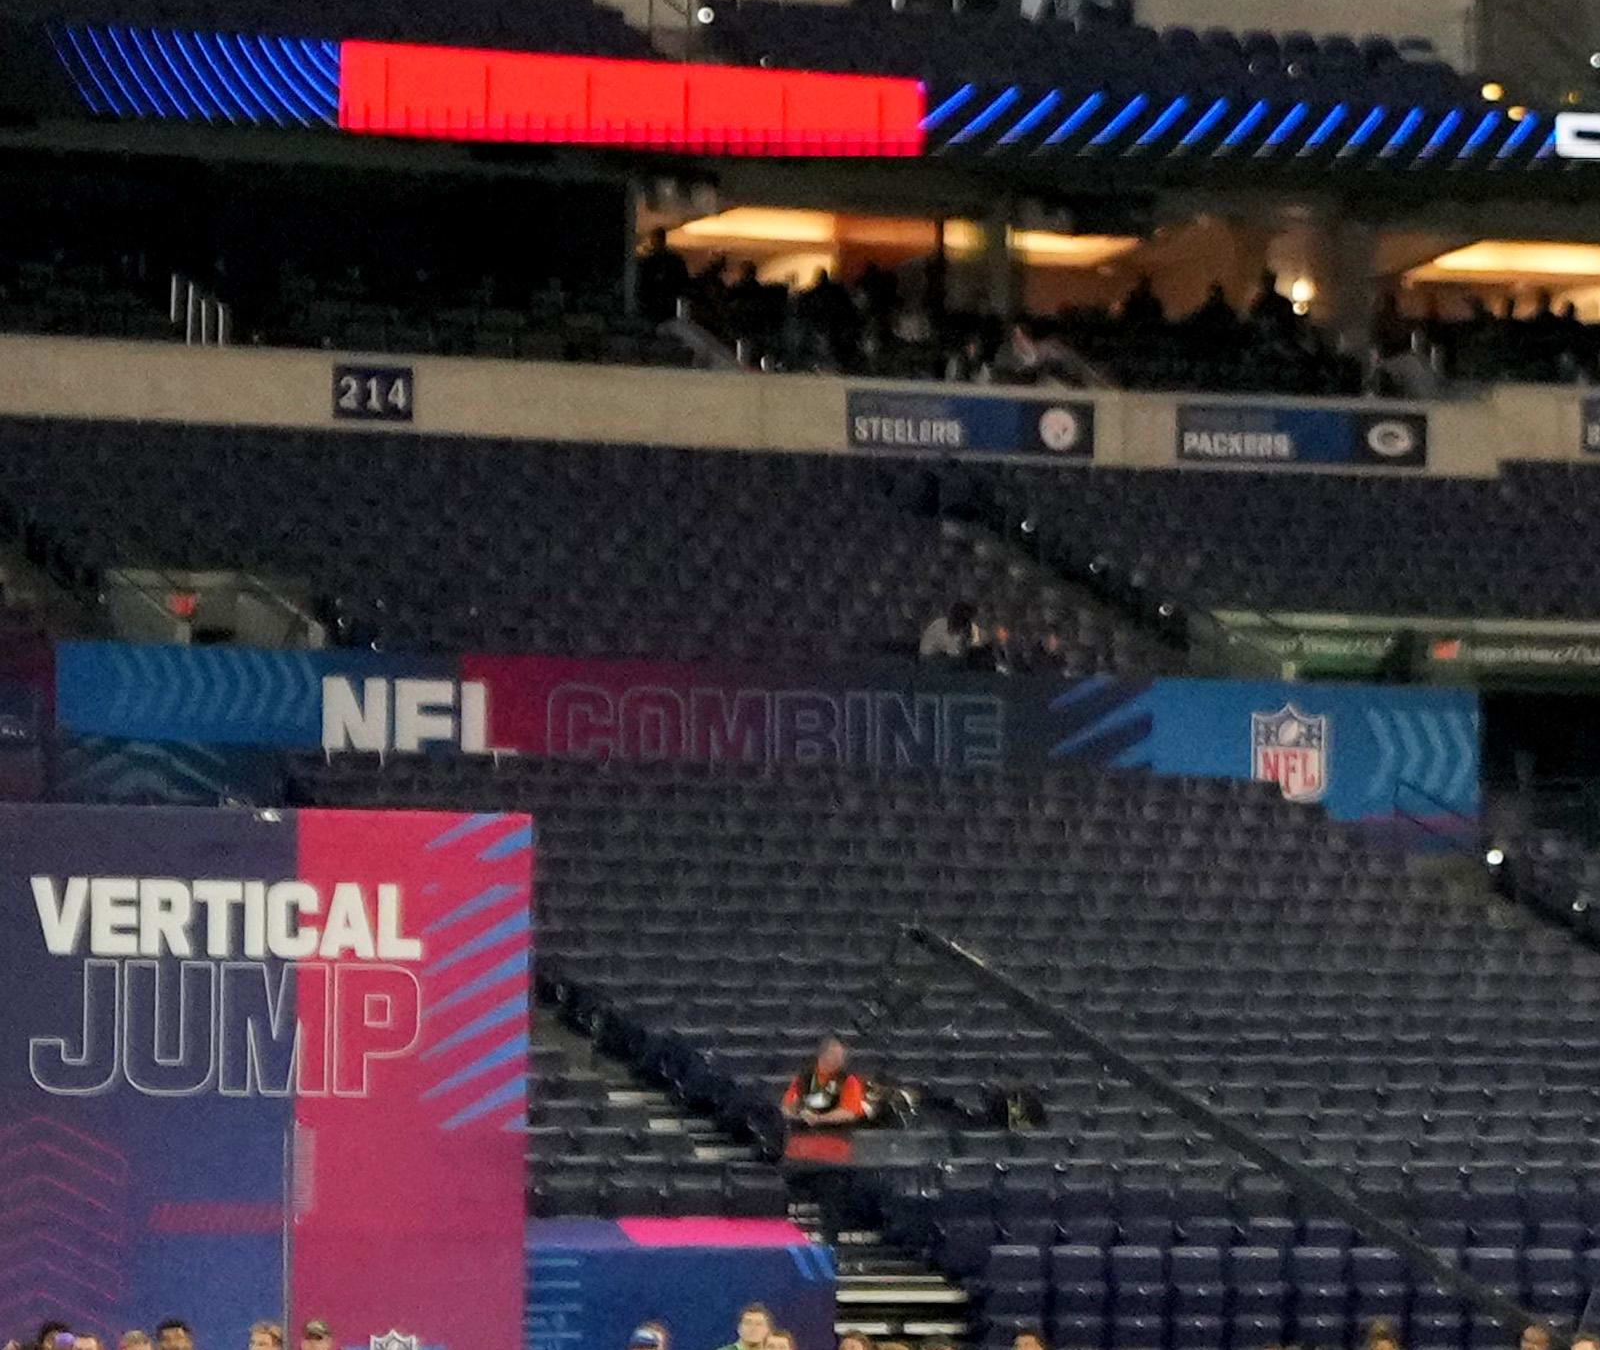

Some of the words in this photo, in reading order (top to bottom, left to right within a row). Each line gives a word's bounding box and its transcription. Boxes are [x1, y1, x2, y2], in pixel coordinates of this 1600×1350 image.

[339, 375, 407, 413] 214
[853, 415, 962, 446] STEELERS
[321, 676, 518, 754] NFL
[546, 682, 1000, 769] COMBINE
[1262, 750, 1317, 796] NFL
[29, 875, 423, 962] VERTICAL
[28, 958, 422, 1098] JUMP
